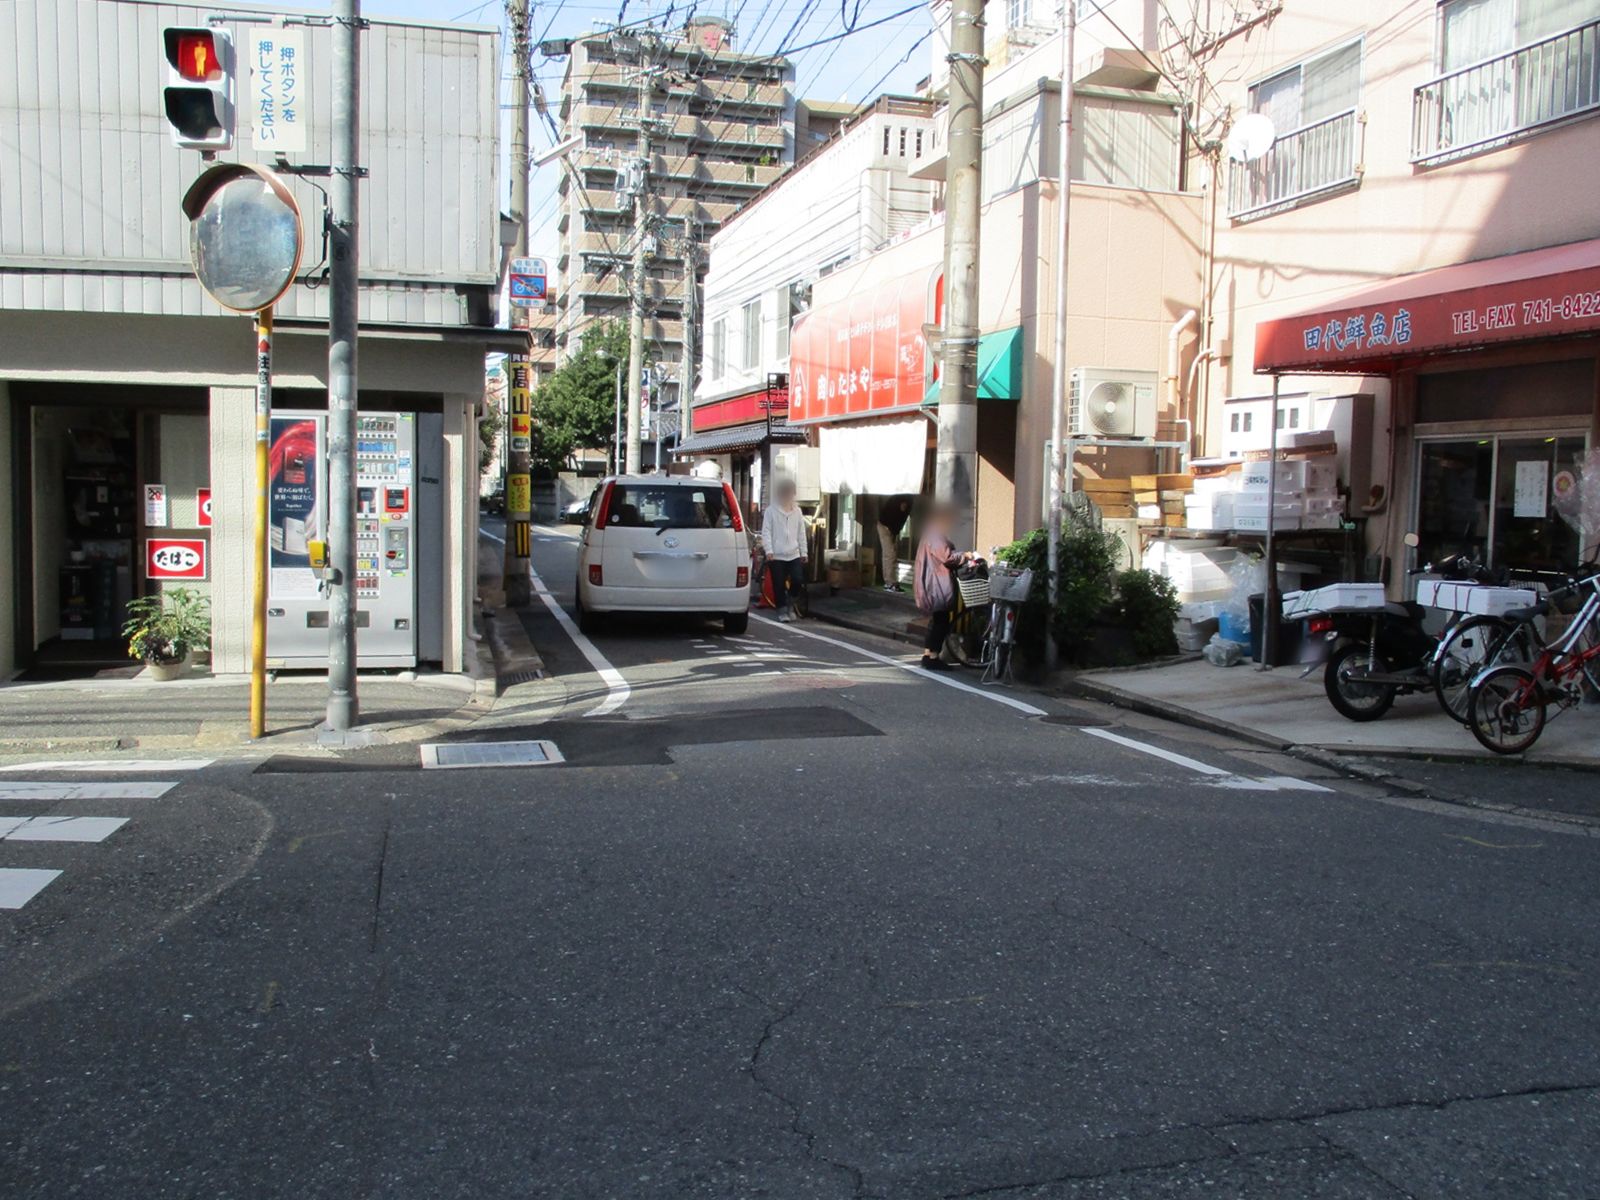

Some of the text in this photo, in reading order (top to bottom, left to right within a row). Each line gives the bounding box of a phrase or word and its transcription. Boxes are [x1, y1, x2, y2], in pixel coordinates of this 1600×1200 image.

[258, 41, 275, 140] 押してください
[280, 47, 296, 122] 押ボタンを
[1303, 308, 1412, 351] 田代鮮魚店
[157, 551, 194, 566] たばこ
